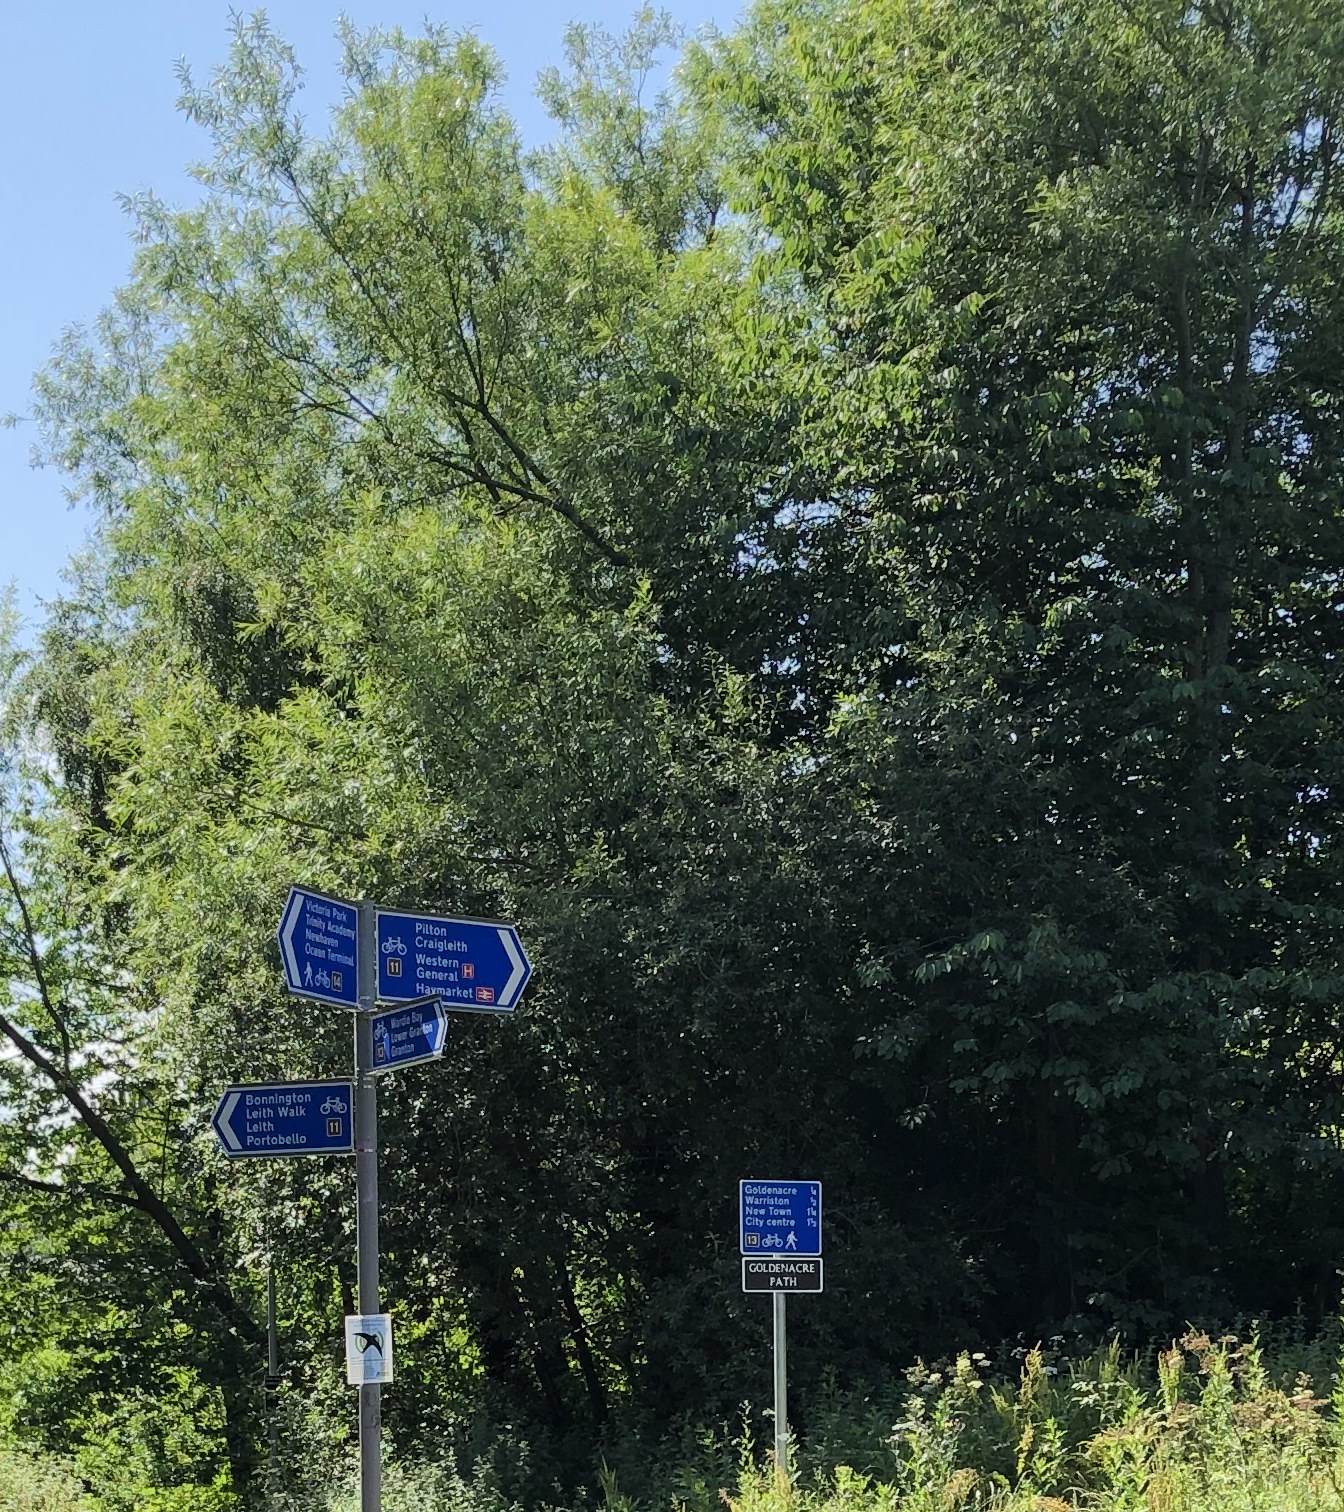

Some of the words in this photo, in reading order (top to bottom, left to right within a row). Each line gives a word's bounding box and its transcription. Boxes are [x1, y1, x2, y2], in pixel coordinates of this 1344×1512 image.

[305, 900, 331, 918] Victoria
[332, 907, 347, 922] Park
[415, 922, 447, 937] Pilton
[415, 936, 468, 952] Craigleith
[390, 961, 399, 973] 11
[415, 953, 459, 969] Western
[416, 967, 459, 982] General
[415, 983, 474, 999] Haymarket
[245, 1093, 311, 1106] Bonnington
[246, 1107, 274, 1120] Leith
[277, 1105, 306, 1118] Walk
[246, 1121, 274, 1133] Leith
[329, 1121, 339, 1133] 11
[246, 1133, 307, 1146] Portobello
[744, 1185, 798, 1195] Goldenacre
[744, 1195, 790, 1206] Warriston
[745, 1206, 766, 1216] New
[769, 1206, 792, 1216] Town
[745, 1217, 764, 1228] City
[766, 1218, 796, 1227] centre
[747, 1235, 757, 1245] 13
[748, 1262, 816, 1274] GOLDENACRE
[769, 1276, 798, 1287] PATH
